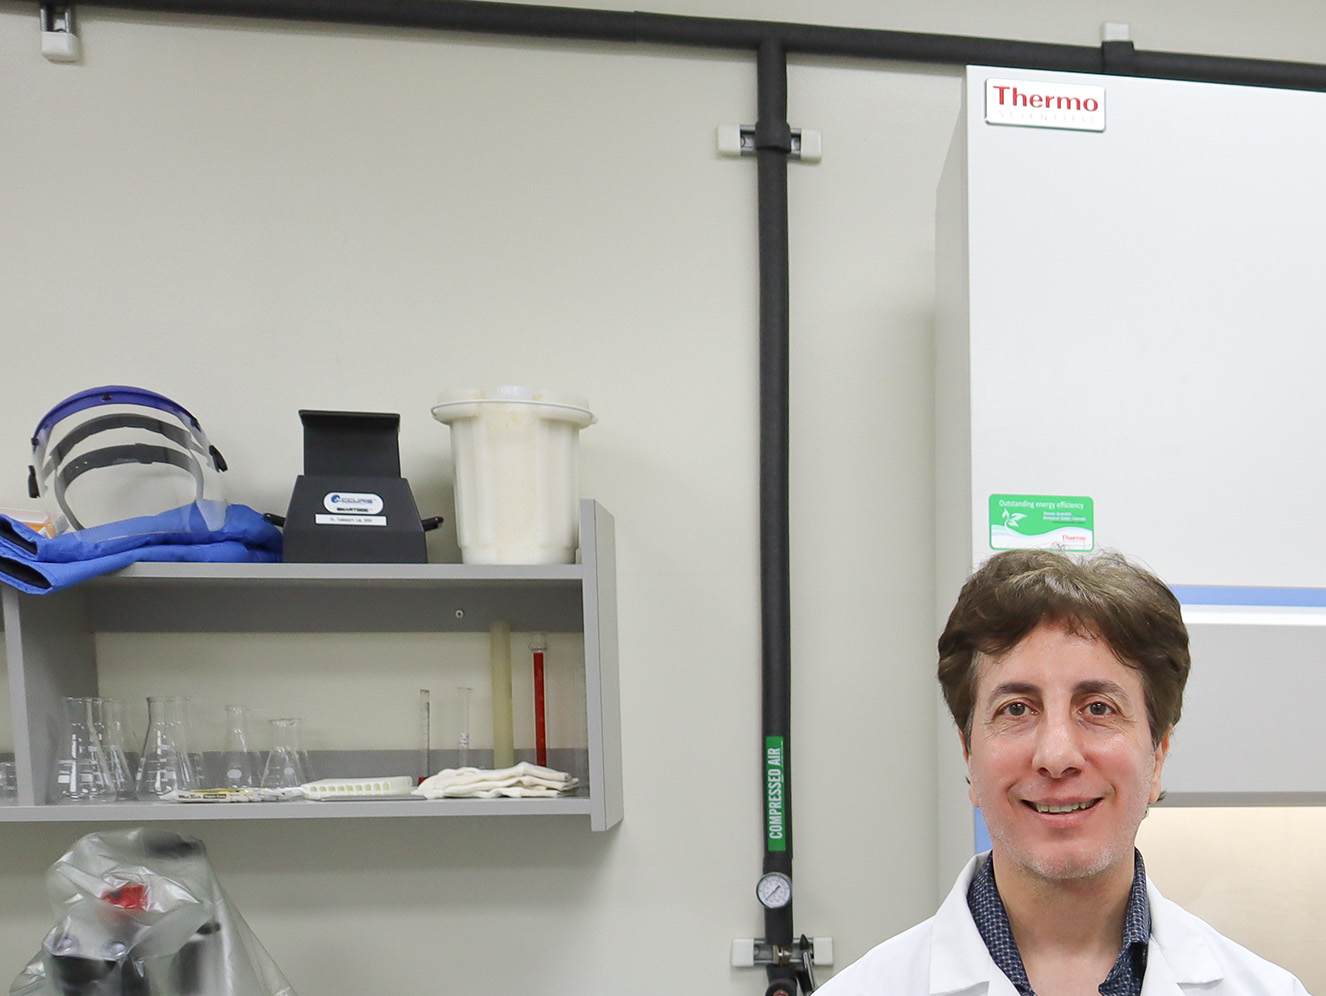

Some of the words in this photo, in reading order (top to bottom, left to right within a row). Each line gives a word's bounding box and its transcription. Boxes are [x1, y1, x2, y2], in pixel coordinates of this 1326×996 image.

[993, 85, 1099, 112] Thermo
[998, 500, 1035, 509] Outstanding
[1036, 501, 1055, 509] energy
[1056, 501, 1085, 510] efficiency
[767, 747, 781, 766] AIR
[767, 768, 783, 839] COMPRESSED
